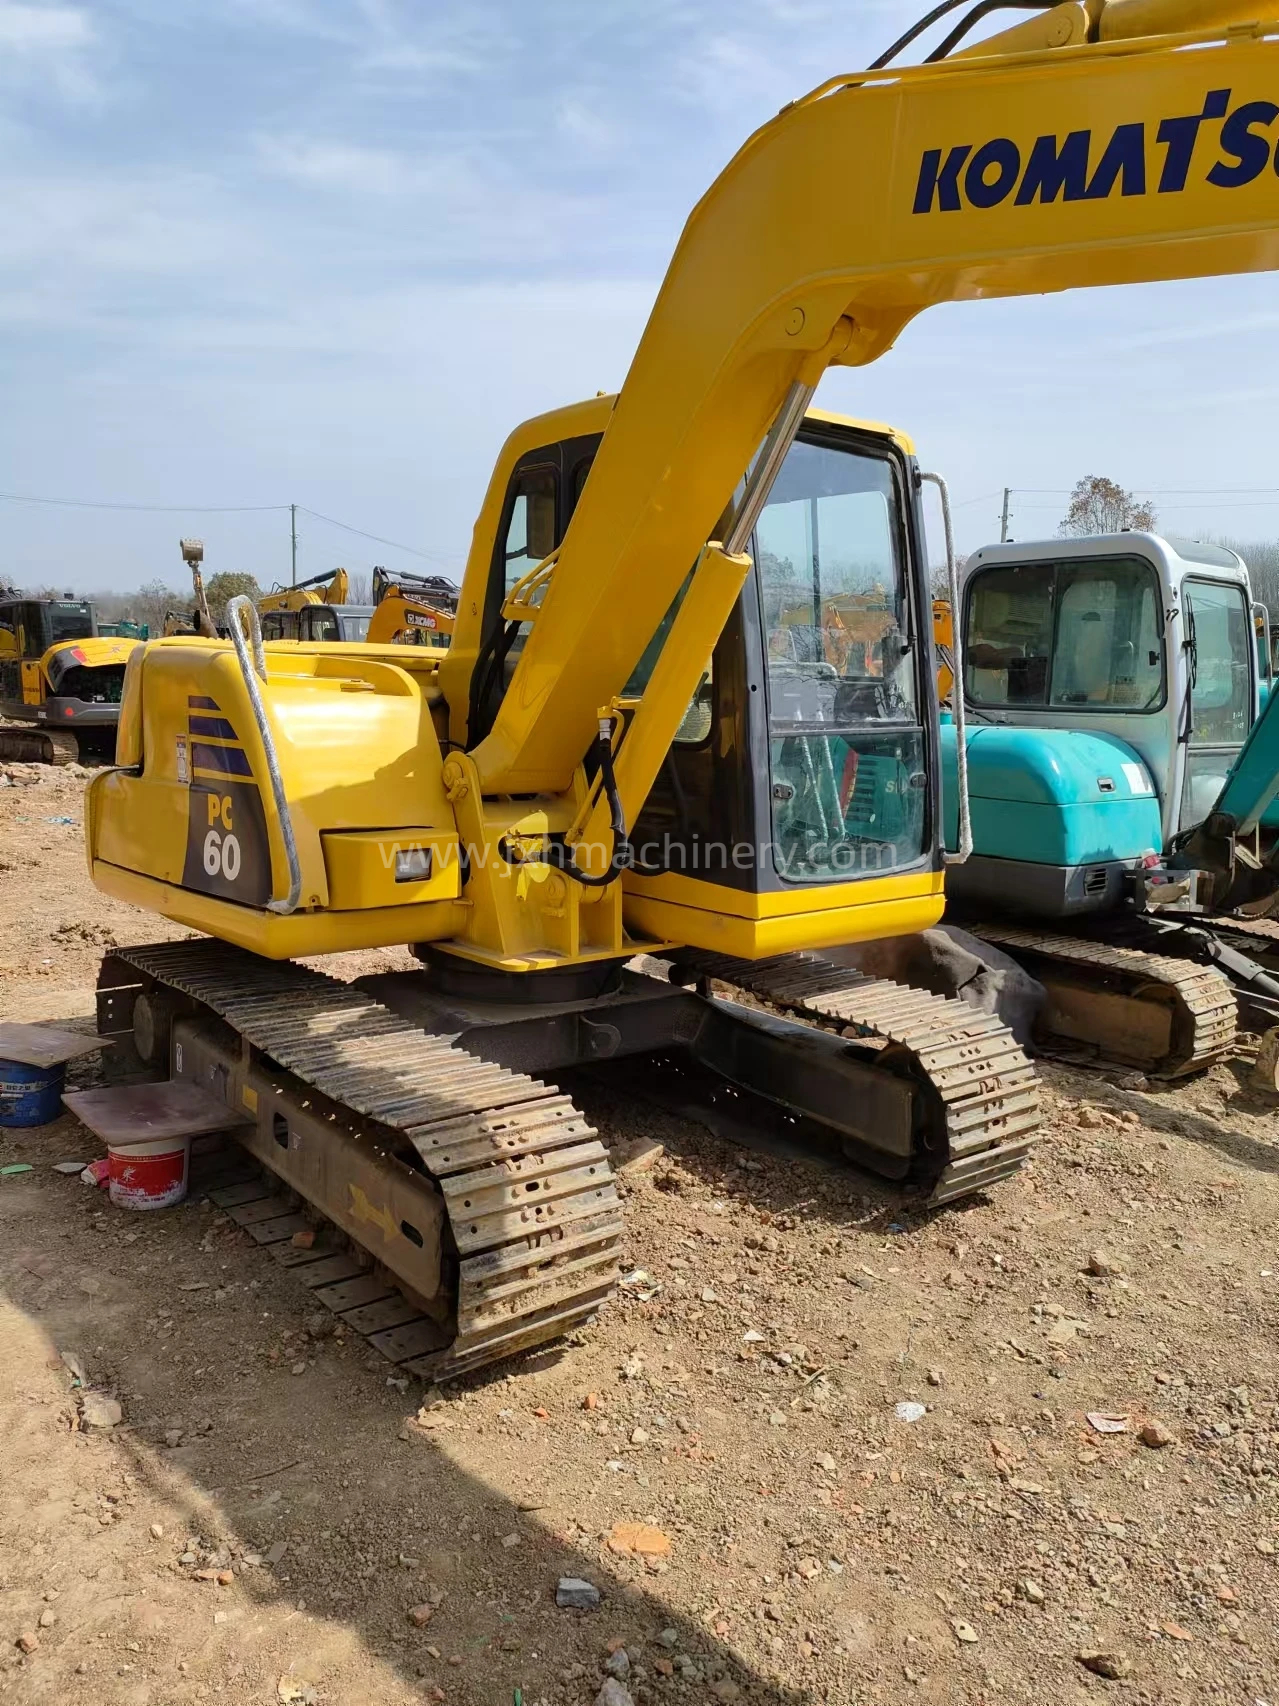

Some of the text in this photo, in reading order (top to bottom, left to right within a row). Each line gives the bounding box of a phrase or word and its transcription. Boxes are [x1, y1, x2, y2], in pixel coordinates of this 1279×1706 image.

[912, 88, 1279, 214] KOMATS
[207, 793, 233, 830] PC
[203, 830, 241, 881] 60
